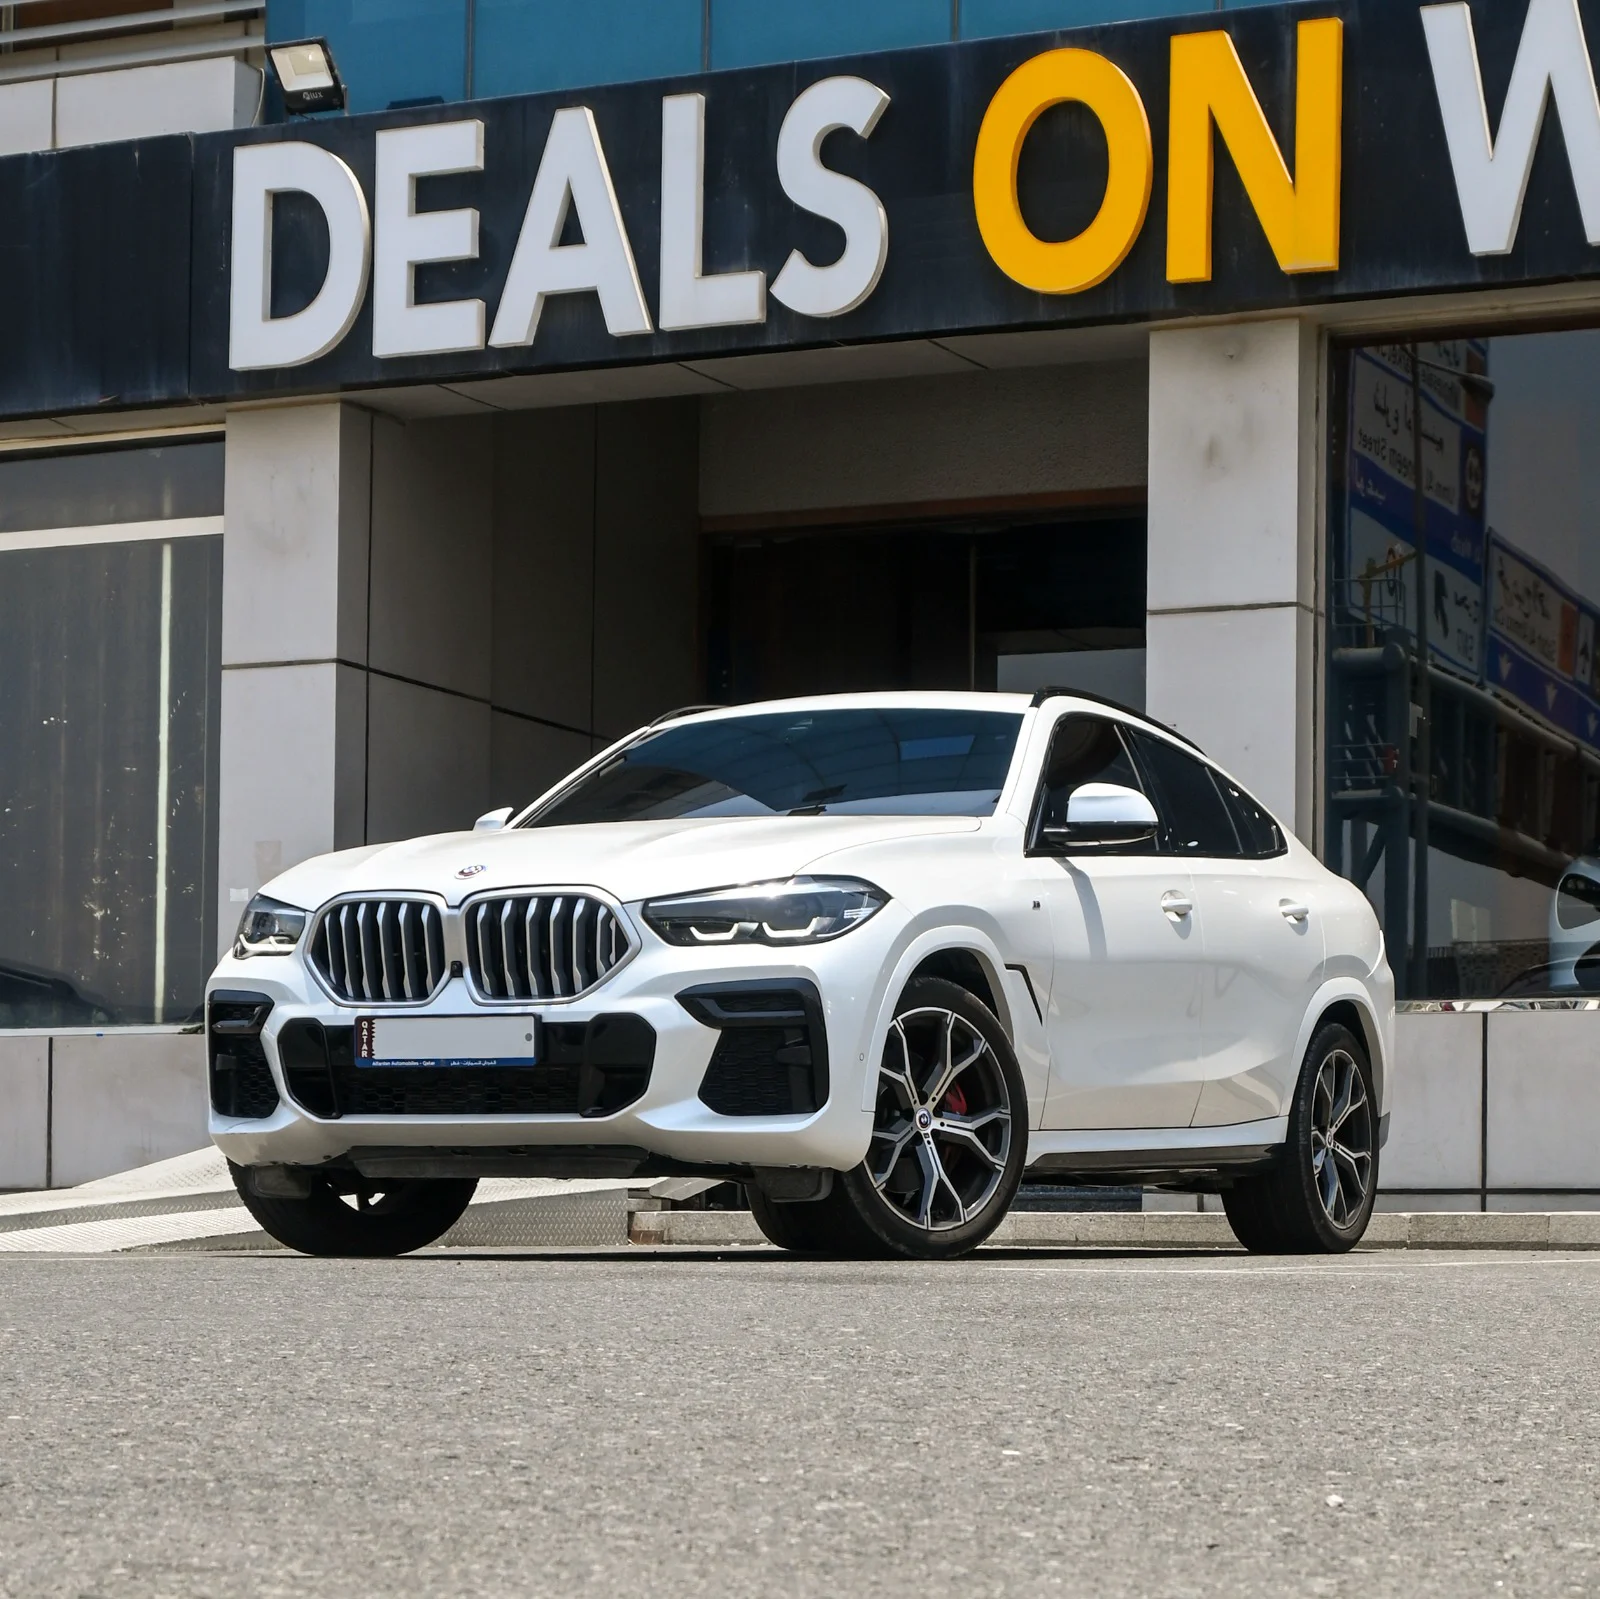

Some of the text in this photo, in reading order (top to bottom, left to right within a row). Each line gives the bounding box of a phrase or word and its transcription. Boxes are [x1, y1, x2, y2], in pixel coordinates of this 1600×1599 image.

[229, 75, 891, 371] DEALS
[973, 17, 1343, 295] ON
[361, 1020, 369, 1058] QATAR
